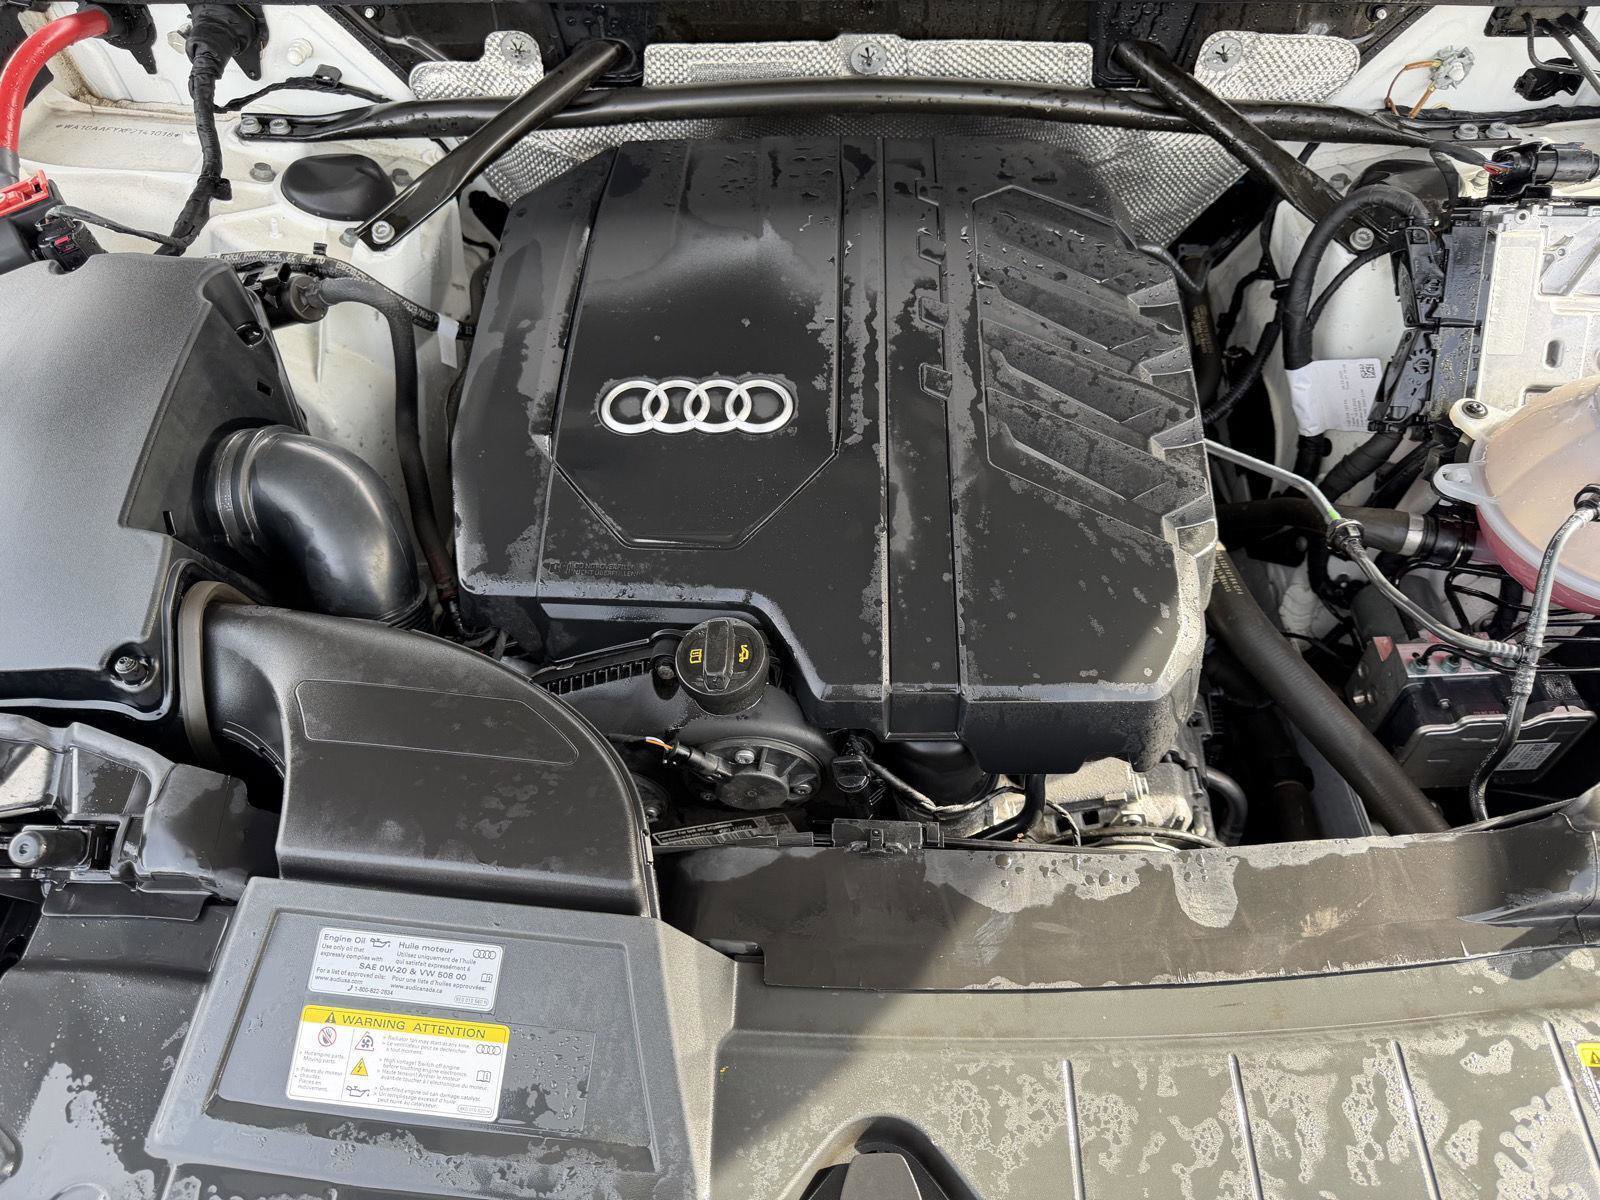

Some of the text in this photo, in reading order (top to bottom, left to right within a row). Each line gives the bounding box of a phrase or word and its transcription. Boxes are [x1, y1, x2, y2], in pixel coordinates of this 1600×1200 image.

[323, 933, 352, 944] Engine
[398, 941, 454, 954] Huile moteur
[320, 951, 345, 959] expressly
[345, 954, 370, 962] complies
[417, 954, 451, 963] uniquement
[358, 962, 377, 971] SAE
[378, 964, 408, 974] 0W-20
[418, 969, 436, 977] VW
[437, 971, 454, 979] 508
[427, 962, 466, 972] expressément
[314, 974, 364, 985] www.audiusa.com
[347, 970, 374, 979] approved
[390, 983, 443, 994] www.audicanada.ca
[341, 1014, 485, 1038] WARNING ATTENTION
